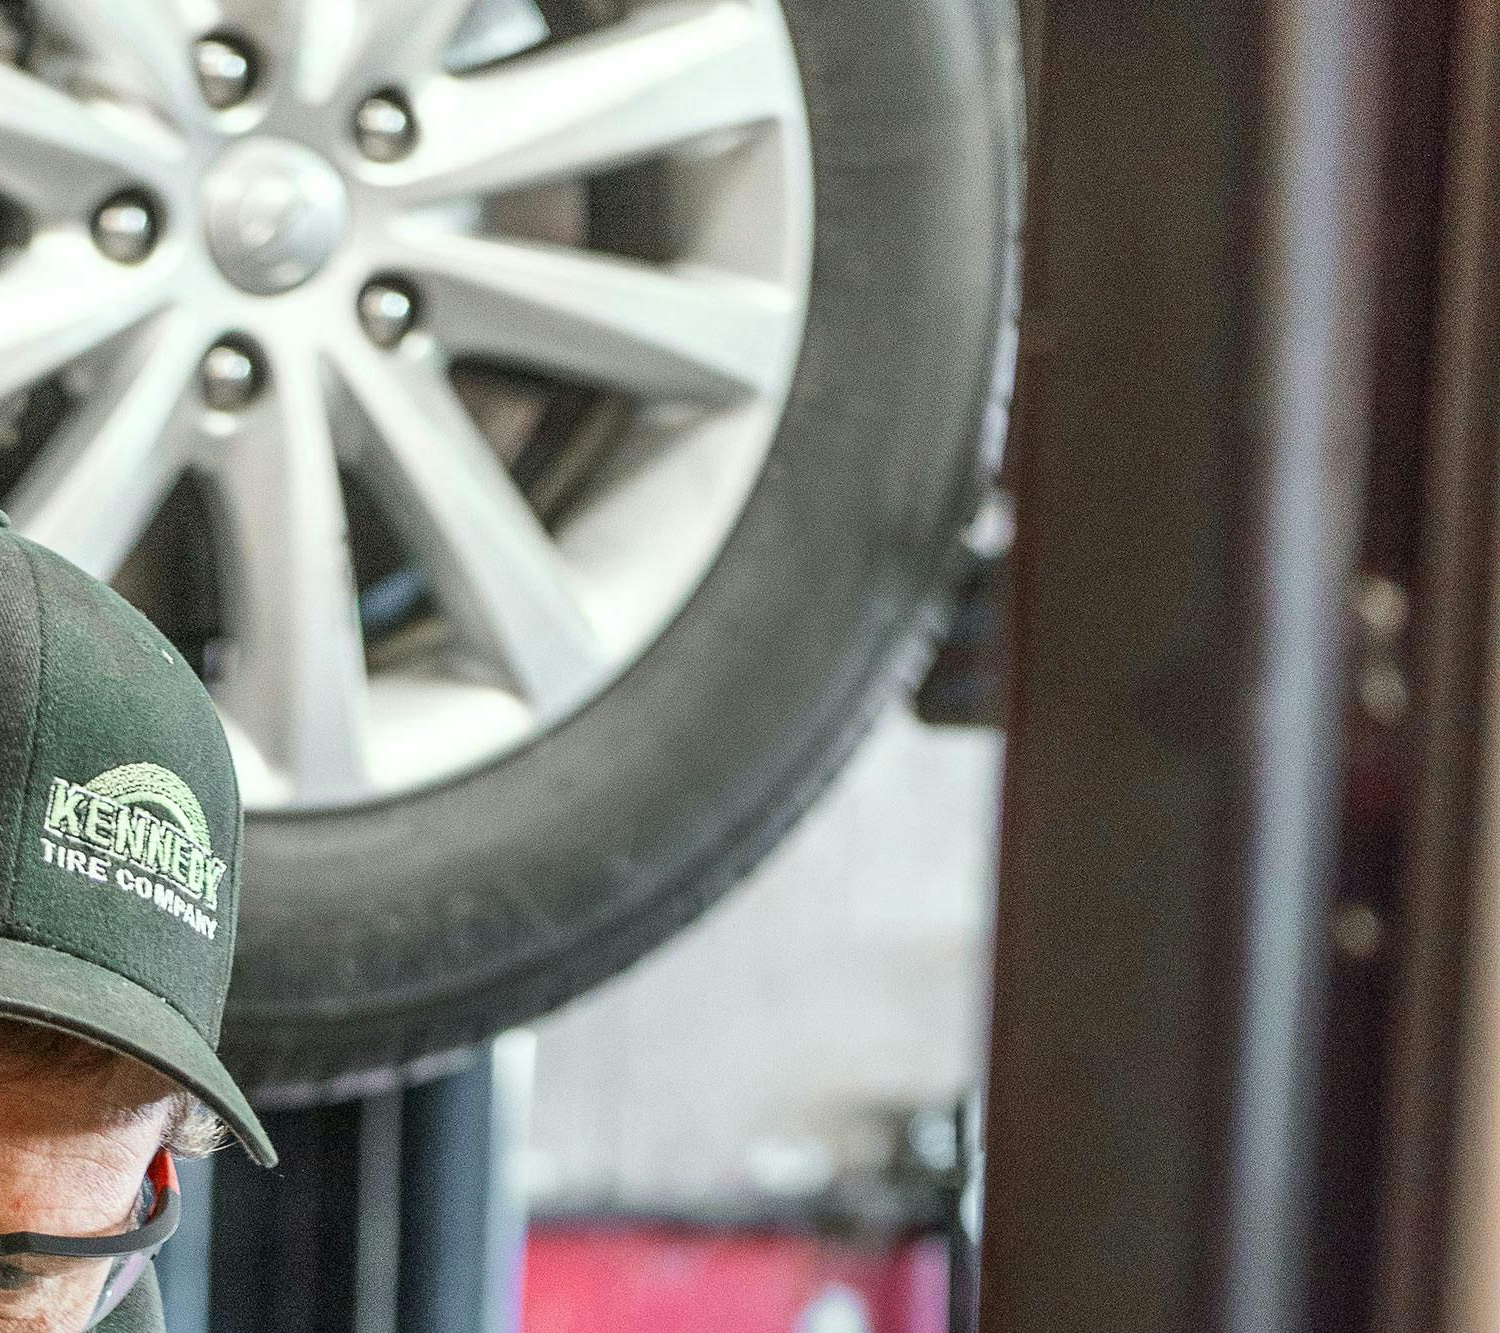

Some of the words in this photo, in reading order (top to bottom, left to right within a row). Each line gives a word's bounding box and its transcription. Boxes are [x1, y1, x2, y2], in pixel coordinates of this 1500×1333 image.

[41, 838, 111, 882] TIRE
[116, 868, 218, 939] COMPANY
[45, 777, 226, 911] KENNEDY
